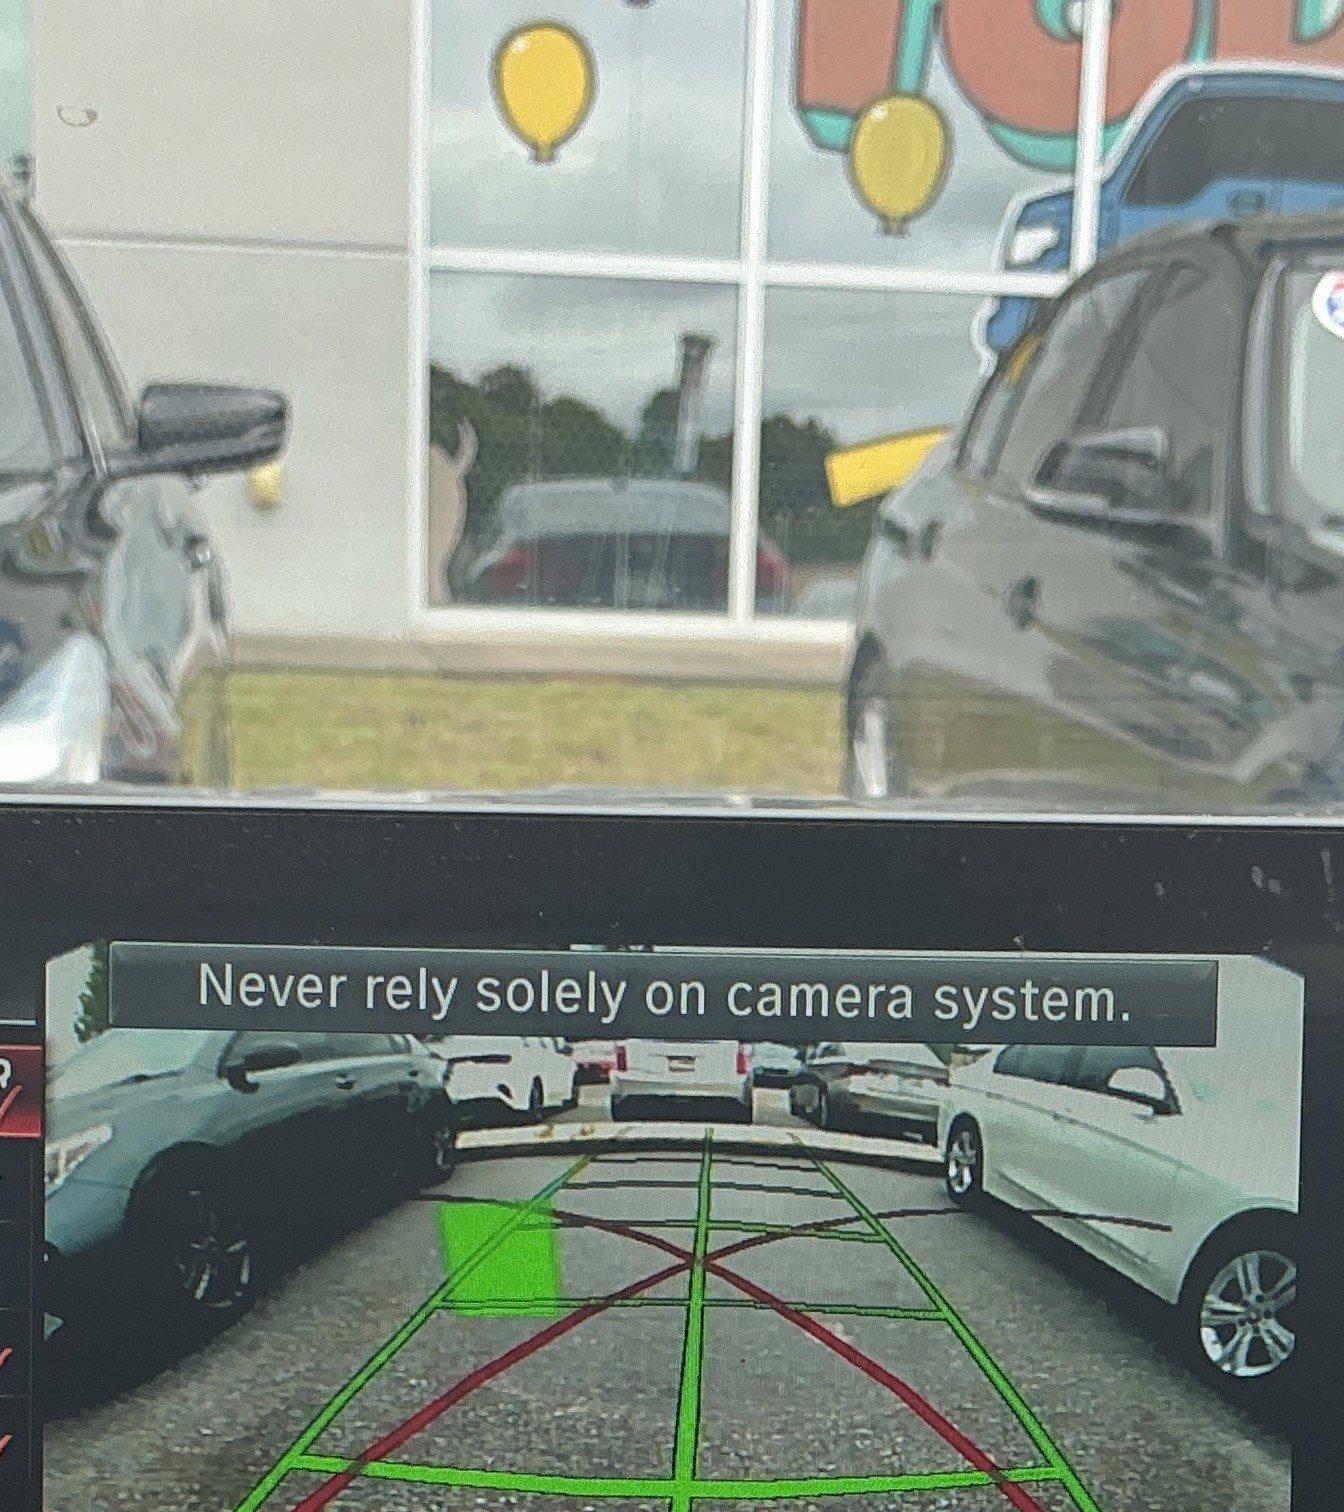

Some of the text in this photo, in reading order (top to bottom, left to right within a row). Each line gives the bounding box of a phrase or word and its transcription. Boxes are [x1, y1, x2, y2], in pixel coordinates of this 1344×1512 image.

[199, 962, 1132, 1030] Never rely solely on camera system.
